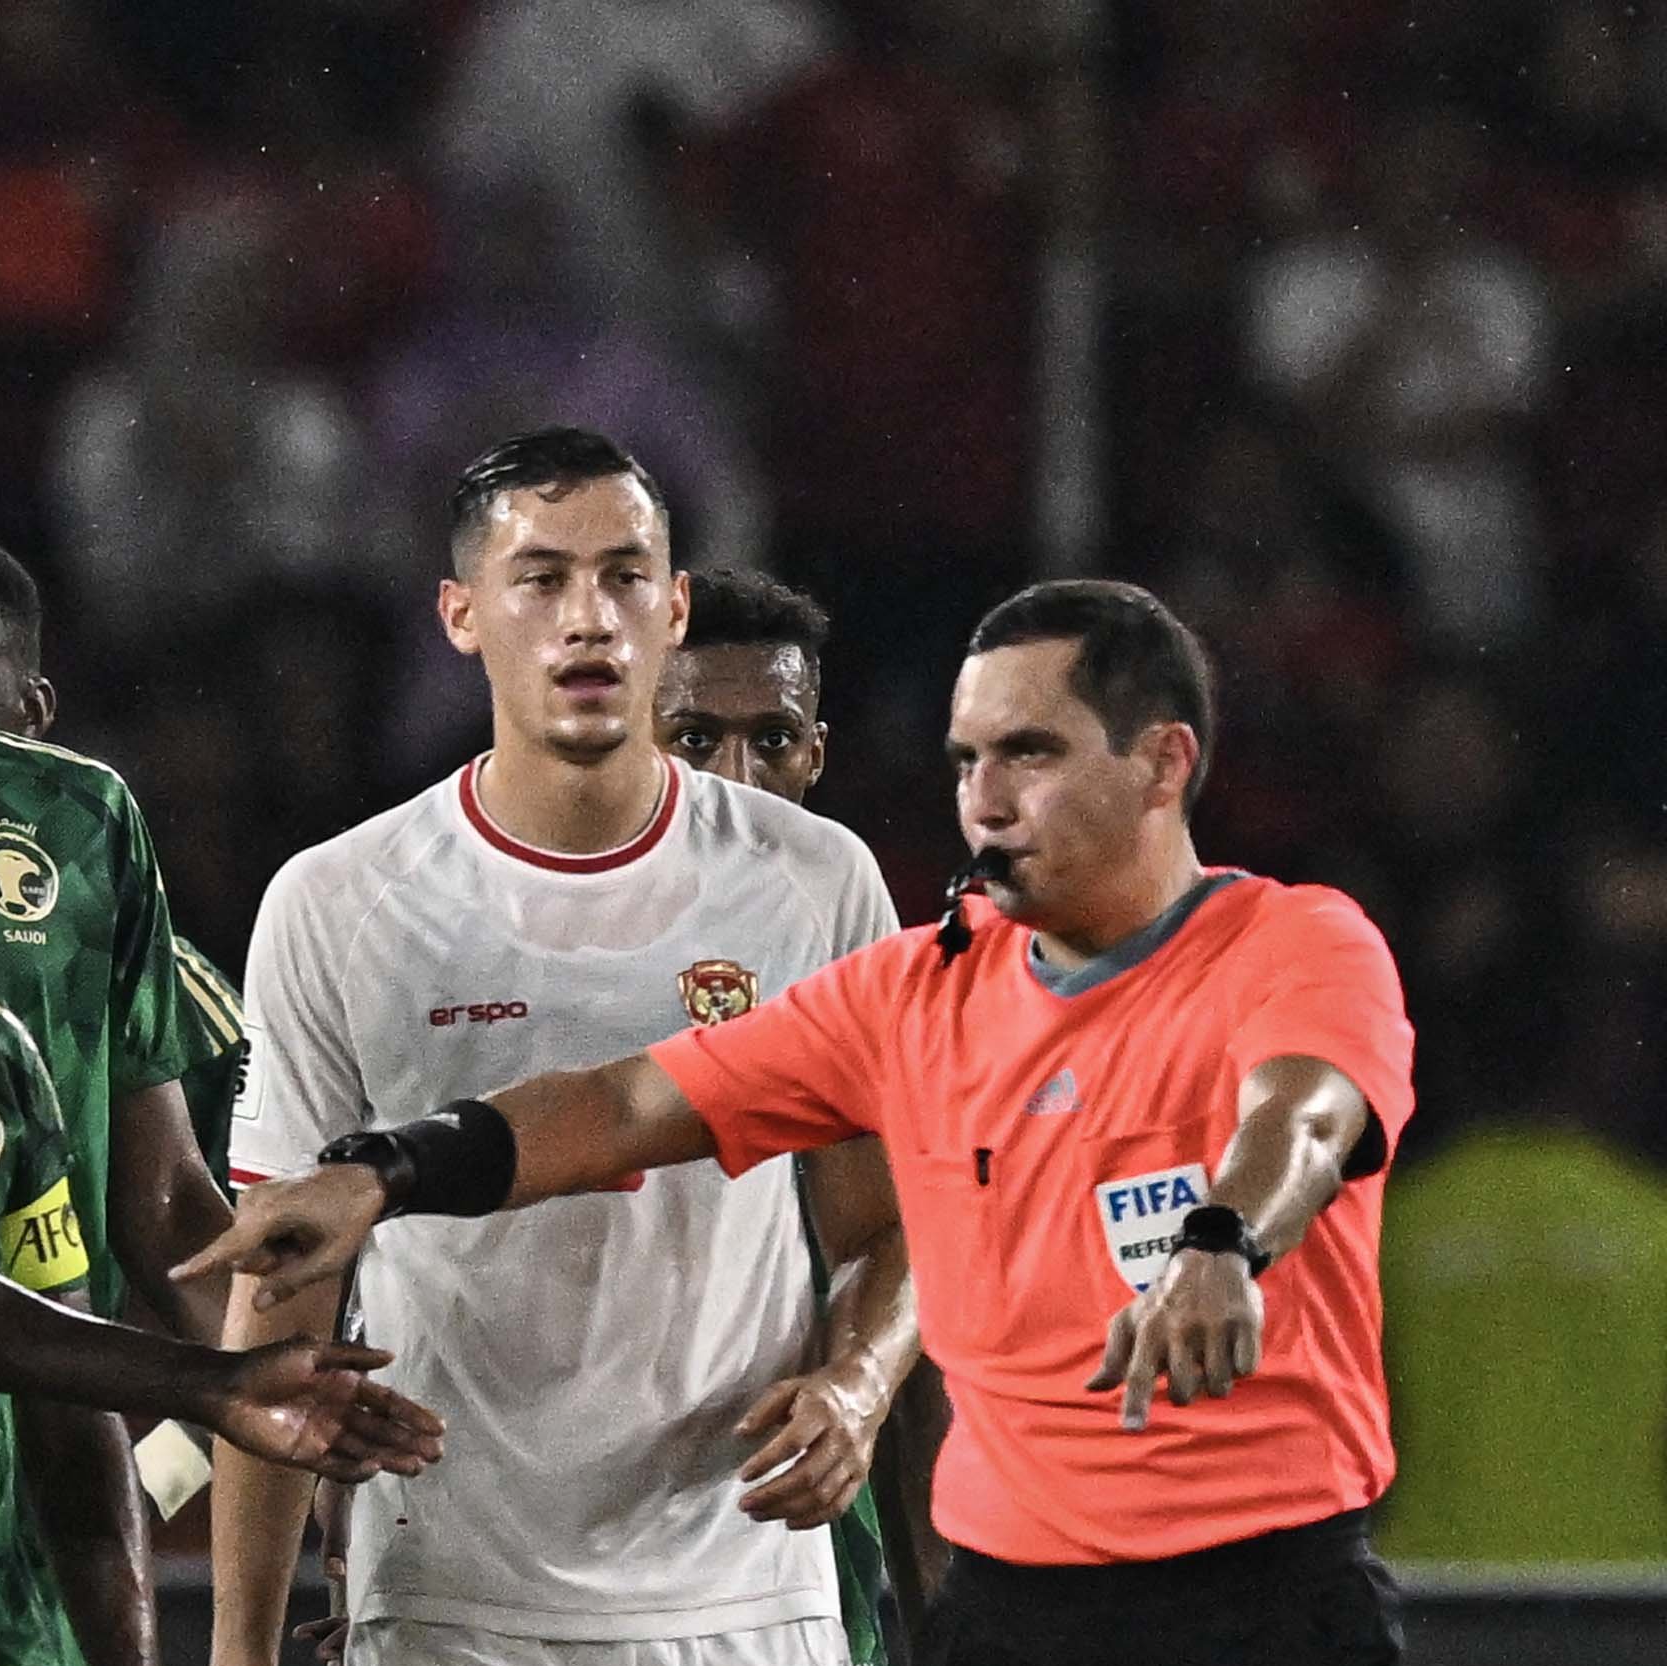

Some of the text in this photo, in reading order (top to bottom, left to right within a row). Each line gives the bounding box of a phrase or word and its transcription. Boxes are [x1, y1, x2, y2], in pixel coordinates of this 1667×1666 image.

[3, 929, 47, 945] SAUDI
[430, 1001, 527, 1026] erspo
[1107, 1176, 1200, 1223] FIFA
[10, 1201, 80, 1270] AFC
